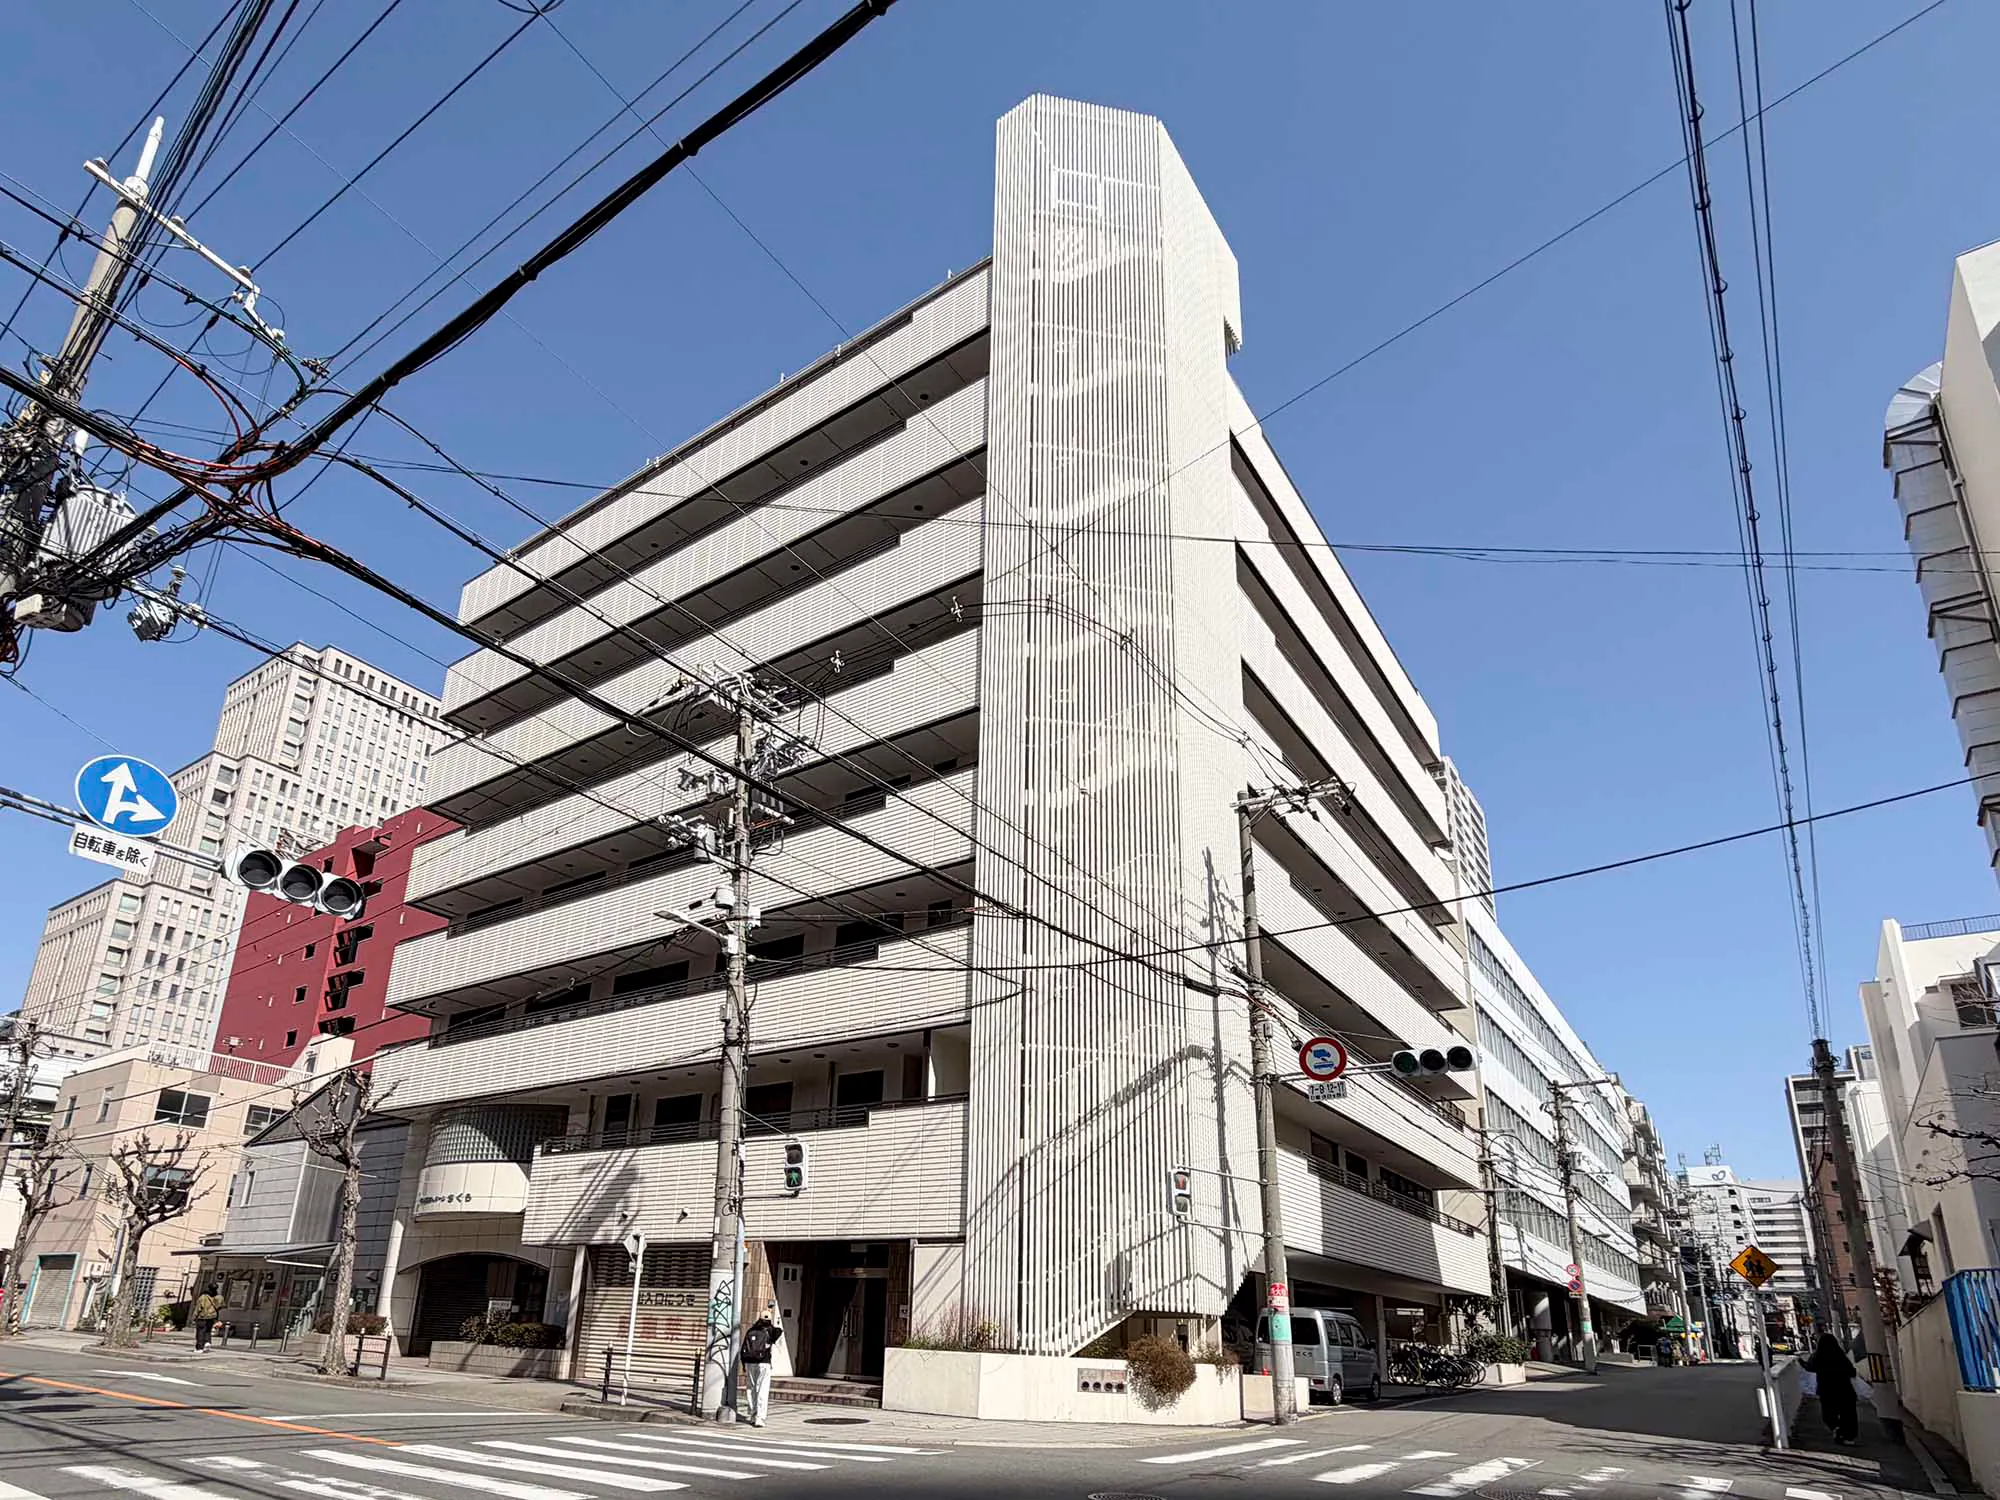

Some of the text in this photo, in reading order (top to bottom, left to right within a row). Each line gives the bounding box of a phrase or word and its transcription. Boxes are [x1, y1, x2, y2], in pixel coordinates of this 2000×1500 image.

[73, 832, 149, 867] 自転車を除く
